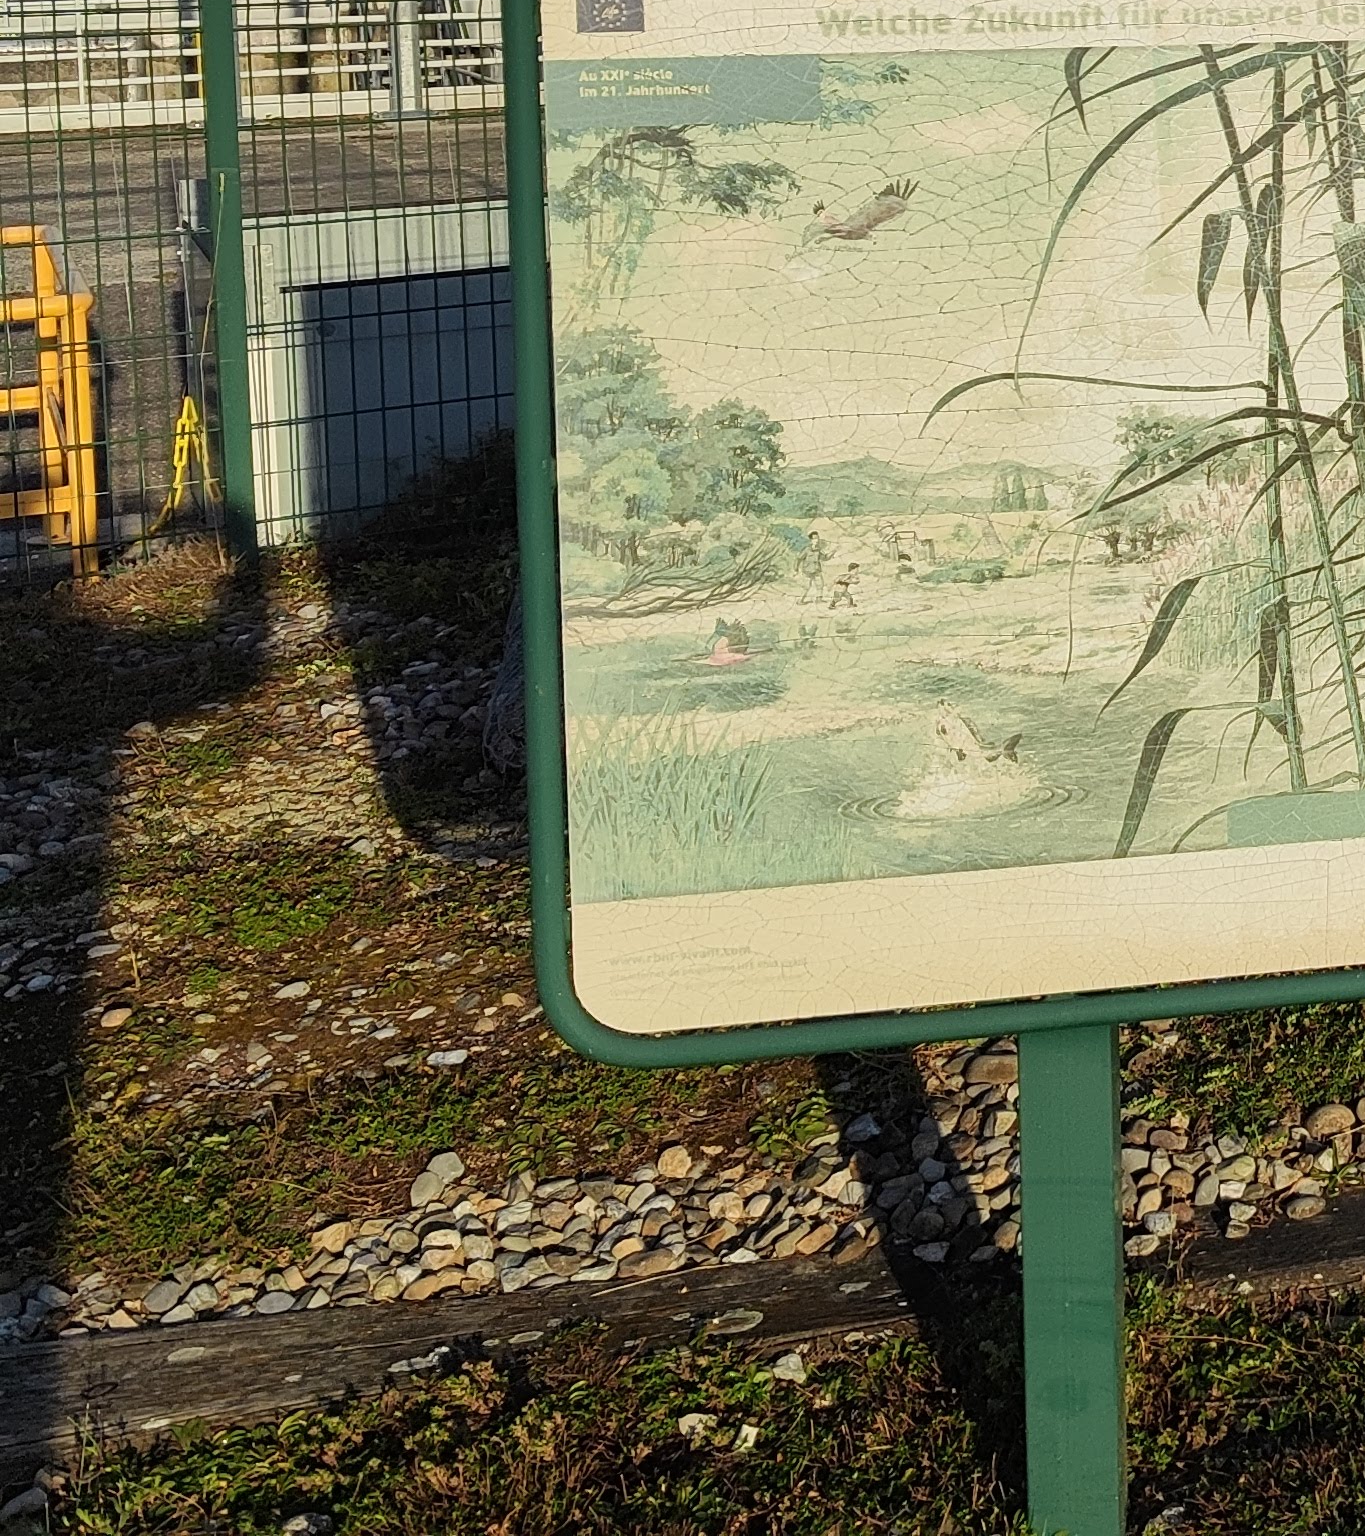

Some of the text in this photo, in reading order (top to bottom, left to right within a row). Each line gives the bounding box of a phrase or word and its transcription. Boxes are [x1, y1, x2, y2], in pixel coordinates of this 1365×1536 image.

[815, 7, 947, 38] Welche
[963, 4, 1106, 34] Zukunft
[1117, 1, 1168, 30] für
[1182, 2, 1303, 27] unsere
[578, 68, 598, 81] Au
[600, 84, 624, 97] 21.
[625, 82, 710, 96] Jahrhundert
